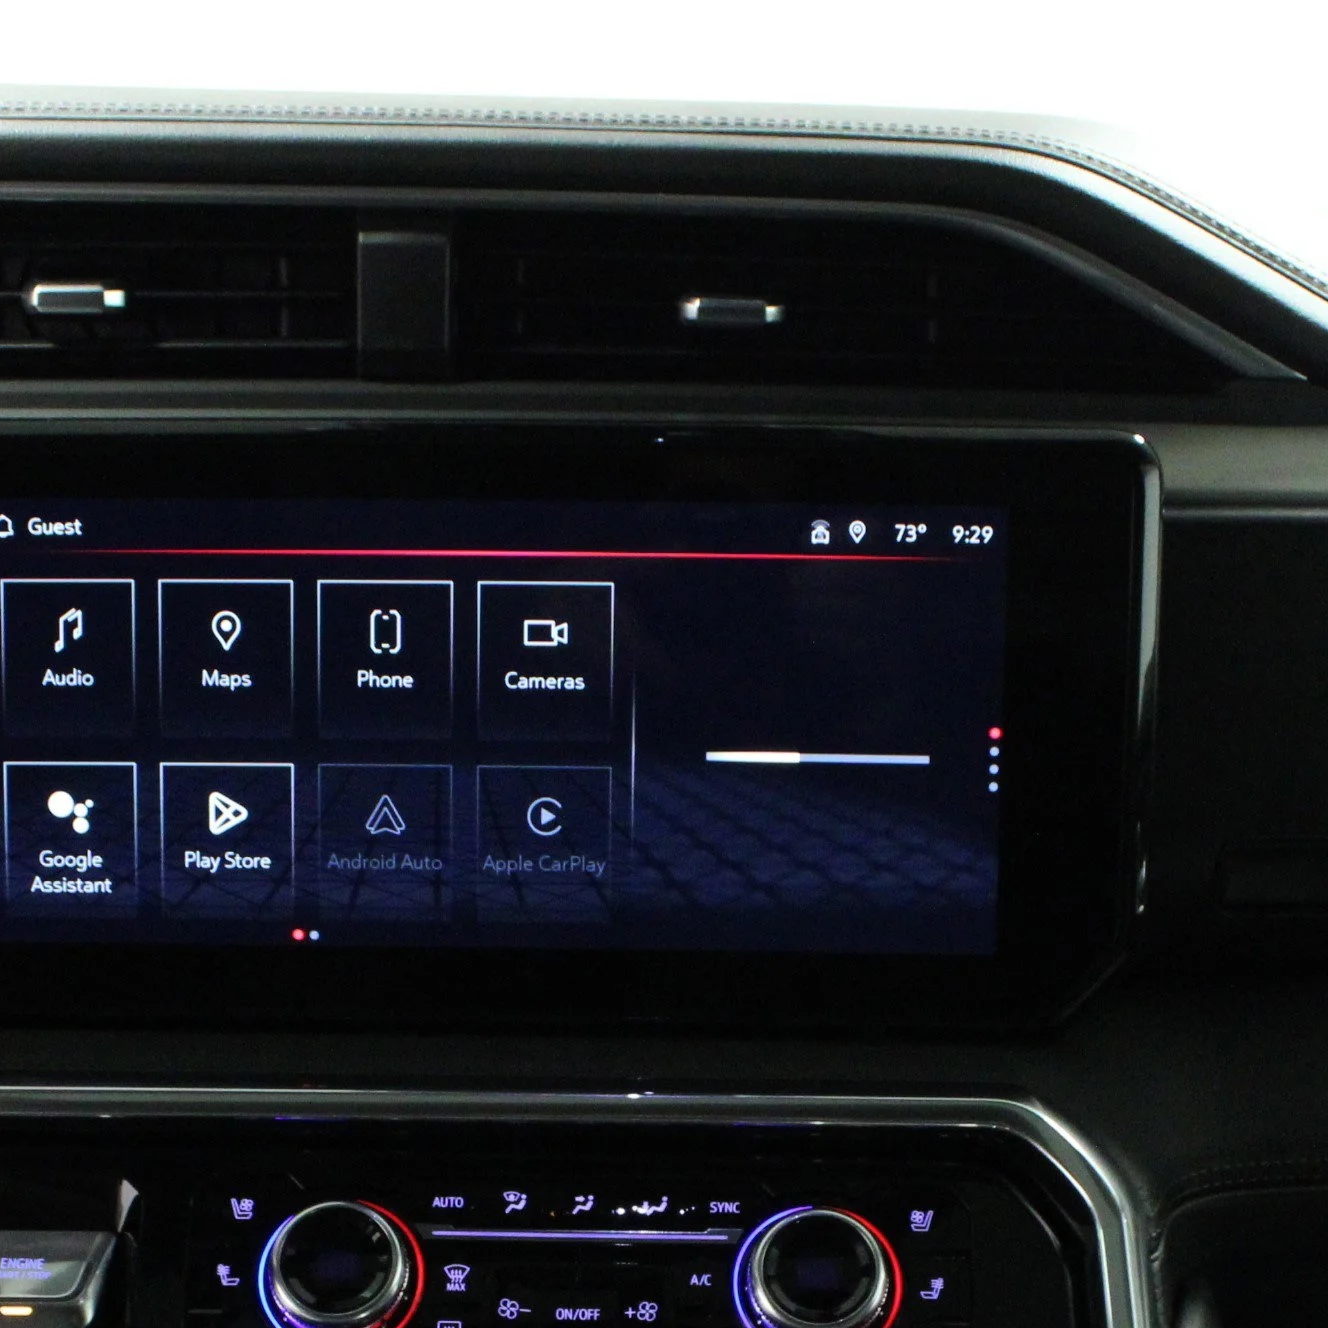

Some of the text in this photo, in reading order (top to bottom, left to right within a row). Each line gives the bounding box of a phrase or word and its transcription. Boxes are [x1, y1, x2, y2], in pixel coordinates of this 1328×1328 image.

[27, 516, 83, 536] Guest
[952, 524, 994, 545] 9:29
[41, 667, 95, 687] Audio
[201, 668, 253, 692] Maps
[357, 669, 415, 689] Phone
[504, 671, 586, 691] Cameras
[37, 849, 104, 872] Google
[184, 850, 272, 874] Play Store
[327, 852, 443, 871] Android Auto
[482, 854, 607, 878] Apple CarPlay
[30, 874, 113, 894] Assistant
[432, 1196, 465, 1209] AUTO
[709, 1201, 741, 1214] SYNC
[0, 1256, 45, 1270] ENGINE
[446, 1282, 466, 1292] MAX
[689, 1273, 713, 1287] A/C
[555, 1307, 602, 1321] ON/OFF
